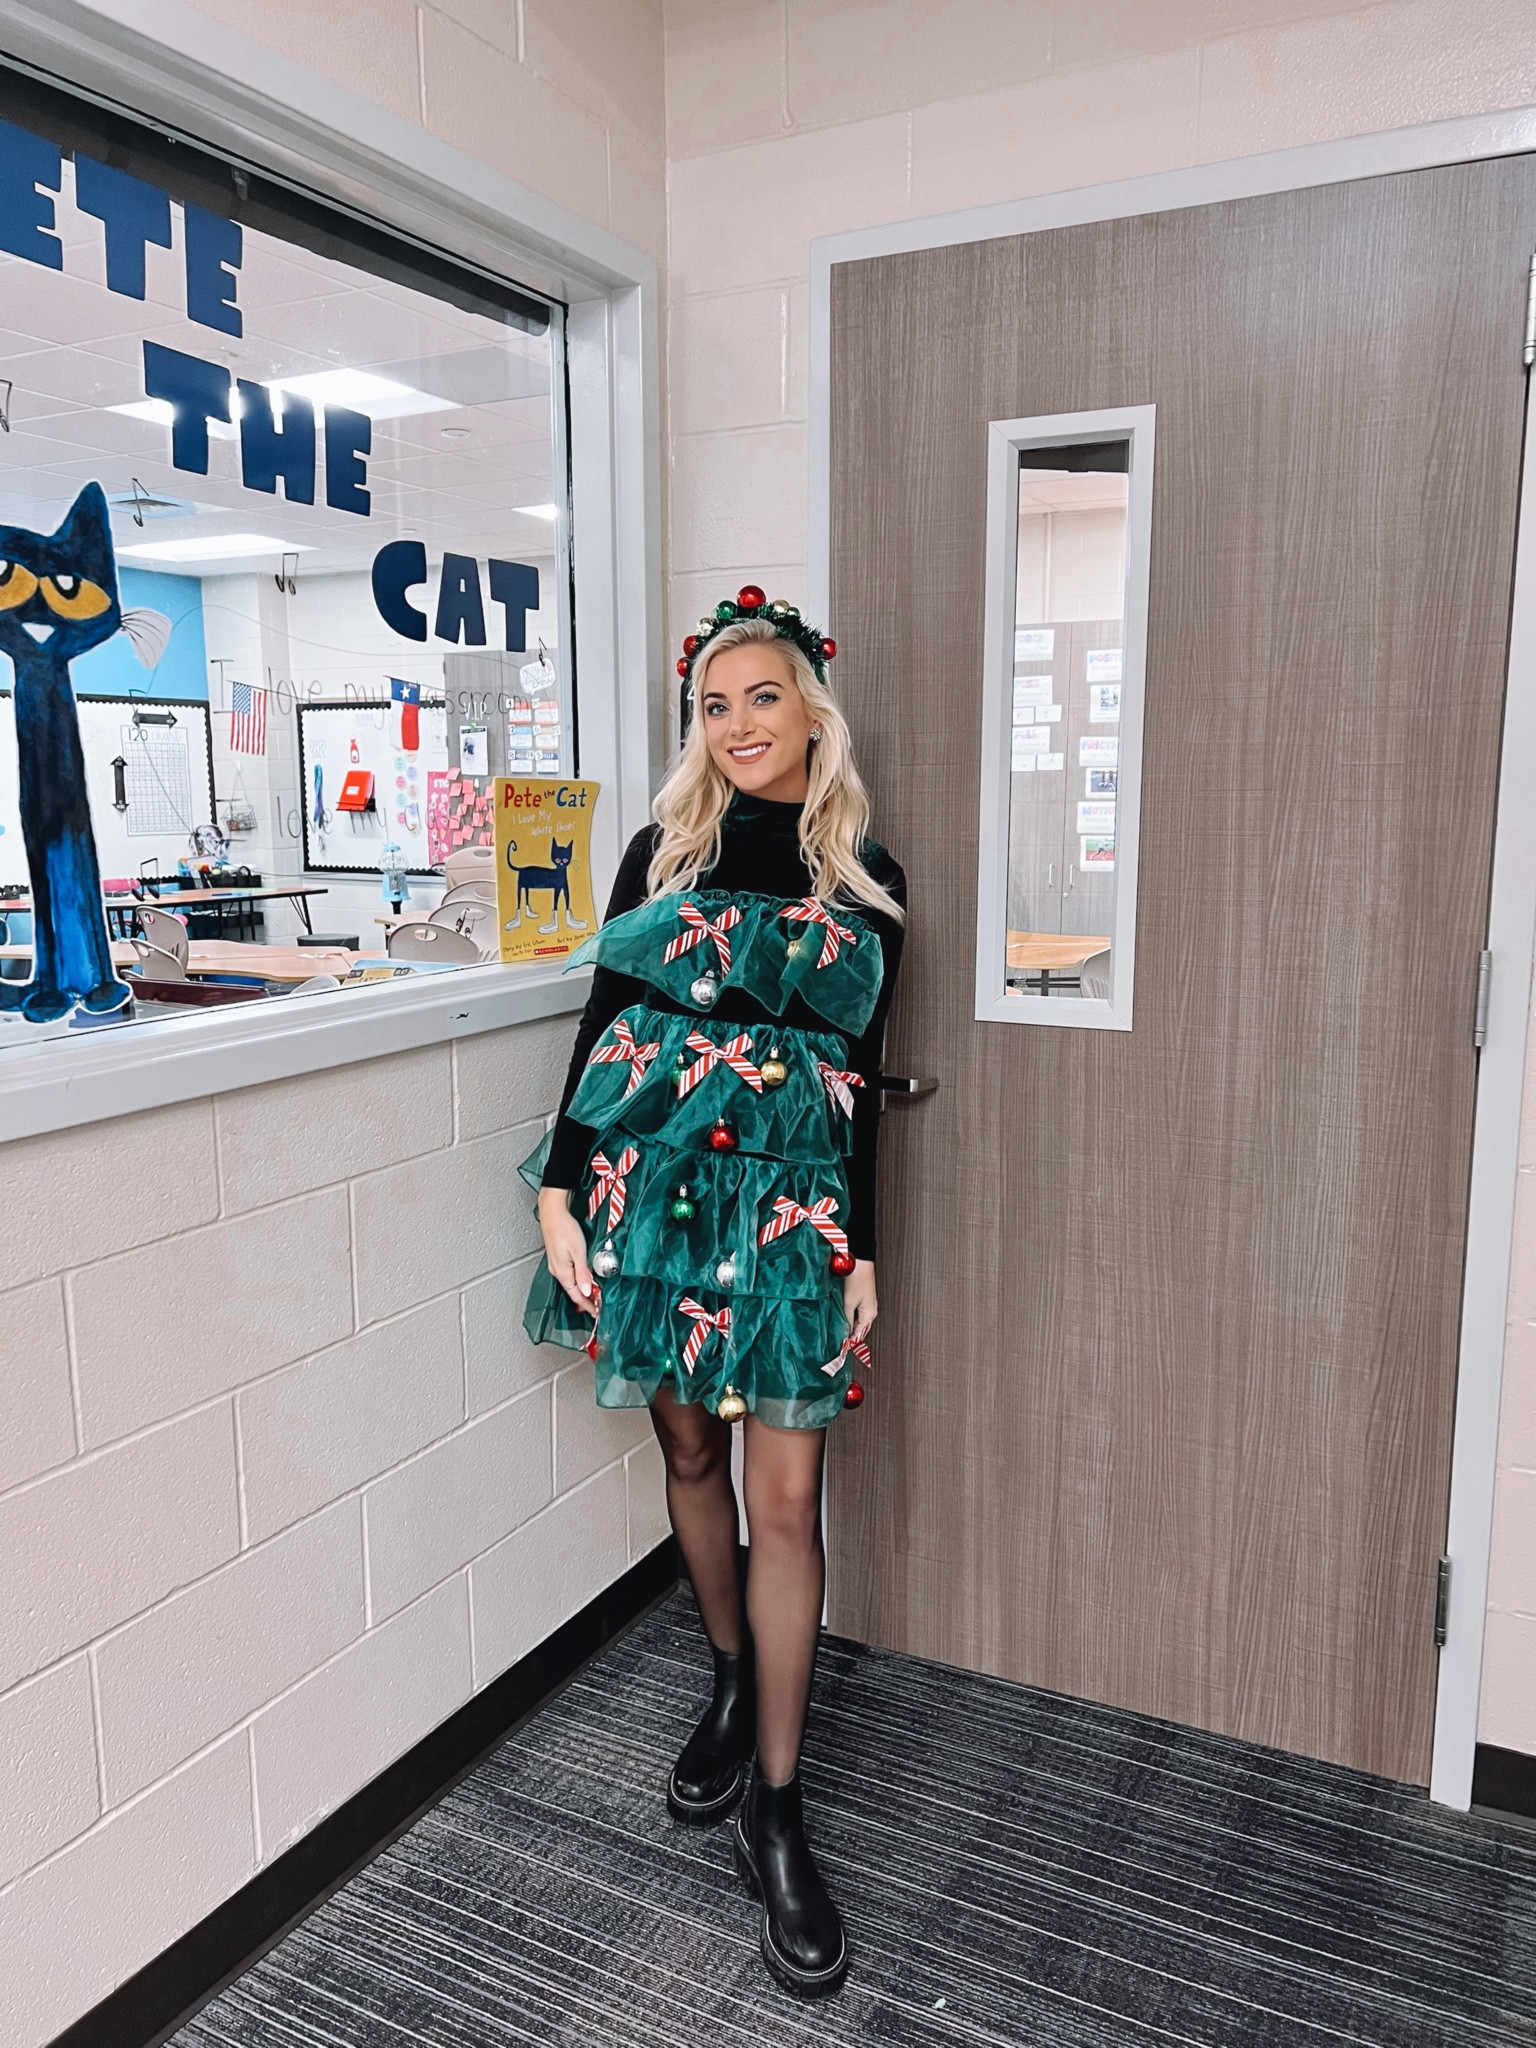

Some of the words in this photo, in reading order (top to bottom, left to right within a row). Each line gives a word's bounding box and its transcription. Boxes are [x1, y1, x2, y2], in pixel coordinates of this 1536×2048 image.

[142, 339, 371, 517] THE
[371, 540, 540, 653] CAT
[268, 667, 323, 716] love
[344, 683, 385, 731] my
[128, 727, 148, 742] 120
[504, 783, 542, 808] Pete
[543, 789, 556, 799] the
[556, 786, 587, 808] Cat
[518, 813, 536, 825] Love
[538, 809, 552, 822] My
